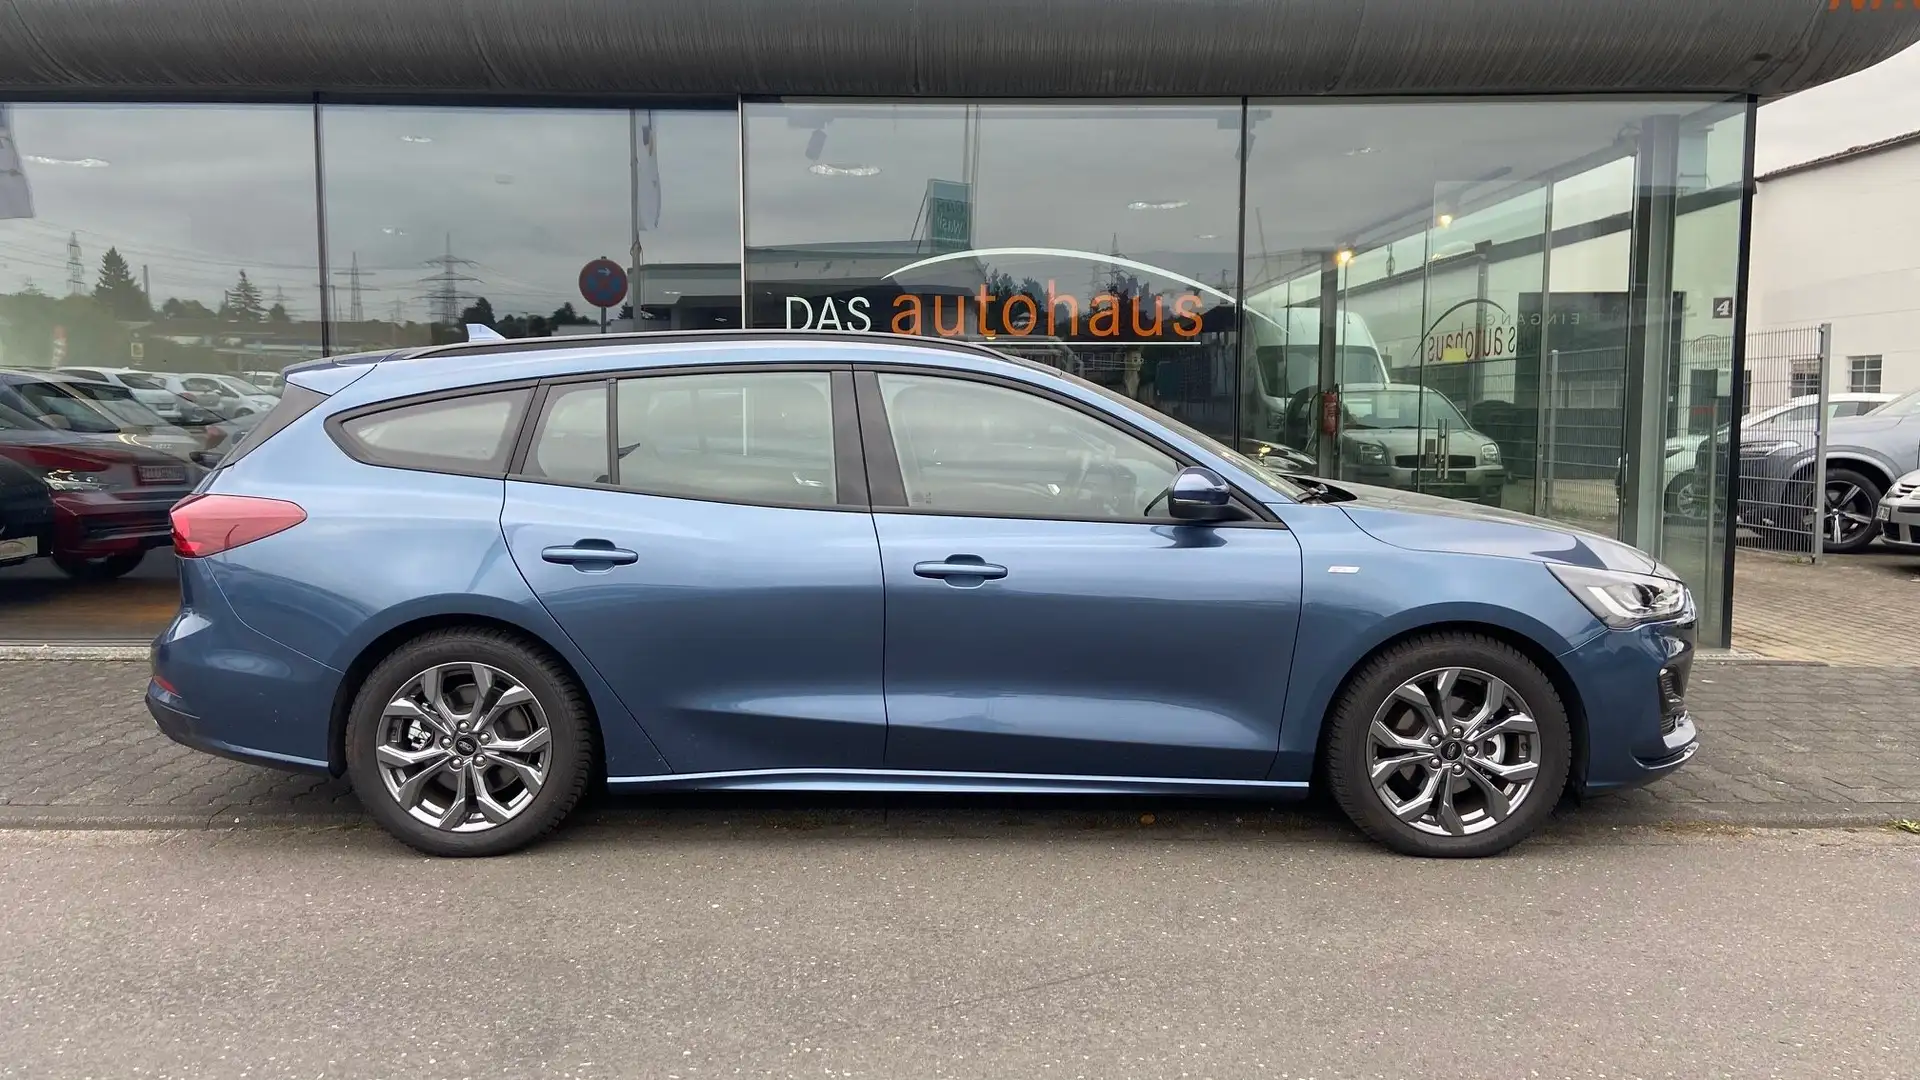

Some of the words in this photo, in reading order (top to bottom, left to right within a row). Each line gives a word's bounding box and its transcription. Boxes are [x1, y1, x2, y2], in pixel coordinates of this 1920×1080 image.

[786, 296, 872, 332] DAS
[892, 279, 1203, 338] autohaus
[1716, 299, 1730, 315] 4
